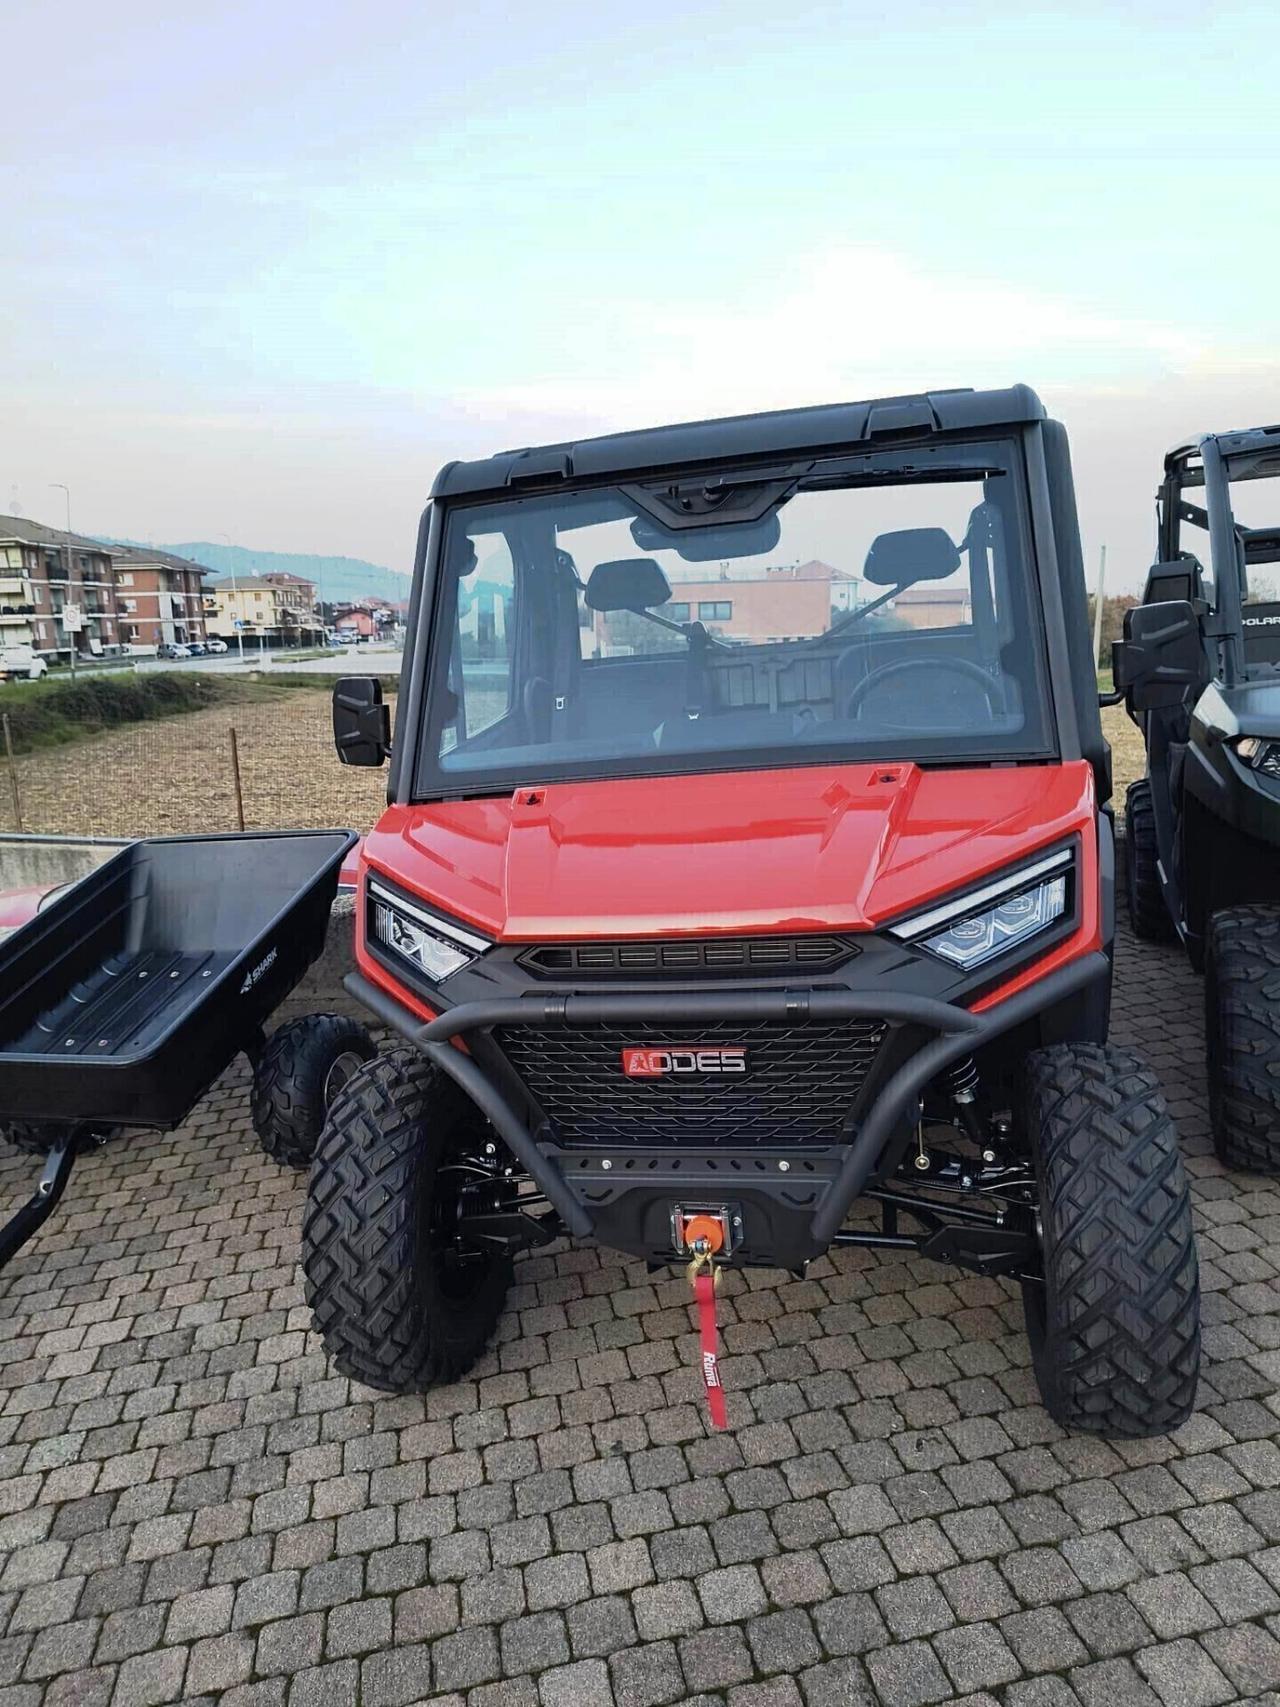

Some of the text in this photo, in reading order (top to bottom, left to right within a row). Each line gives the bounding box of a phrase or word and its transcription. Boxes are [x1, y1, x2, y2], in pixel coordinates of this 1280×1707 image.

[252, 946, 278, 982] SHARK
[628, 1051, 746, 1073] AODES
[703, 1351, 718, 1387] Runva
